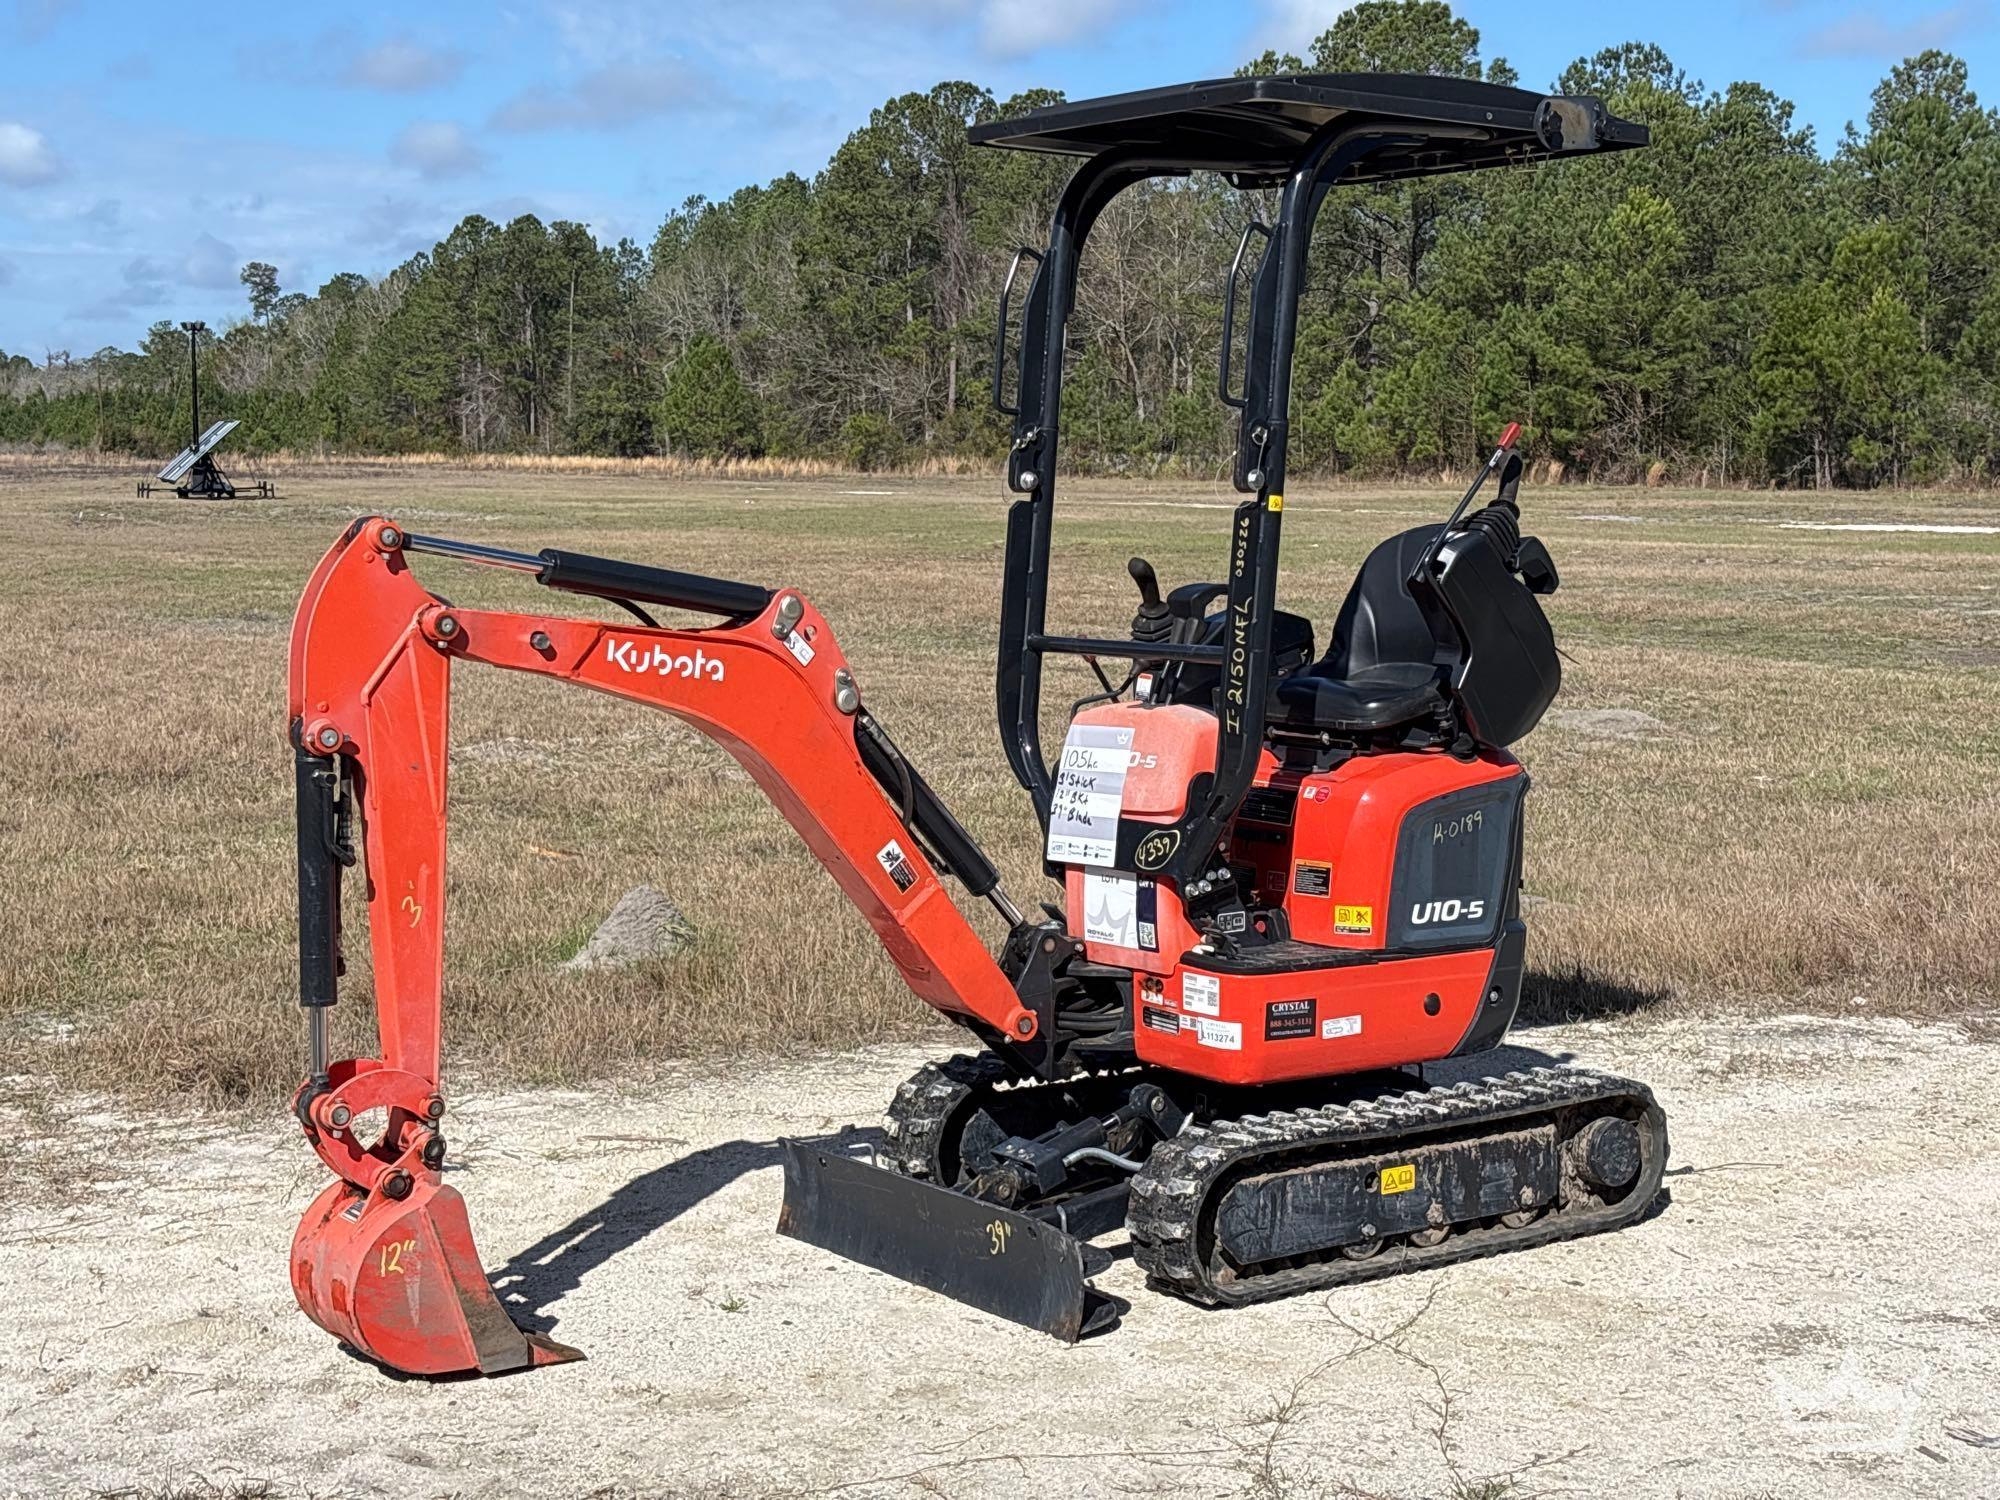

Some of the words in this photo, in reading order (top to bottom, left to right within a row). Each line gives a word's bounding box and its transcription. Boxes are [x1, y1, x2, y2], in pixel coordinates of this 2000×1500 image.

[1235, 517, 1250, 577] 030526
[607, 639, 725, 682] Kubota
[1138, 837, 1170, 867] 4339
[1411, 899, 1485, 925] U10-5
[1272, 1001, 1310, 1012] CRYSTAL
[986, 1219, 1011, 1255] 39"
[380, 1239, 416, 1278] 12"
